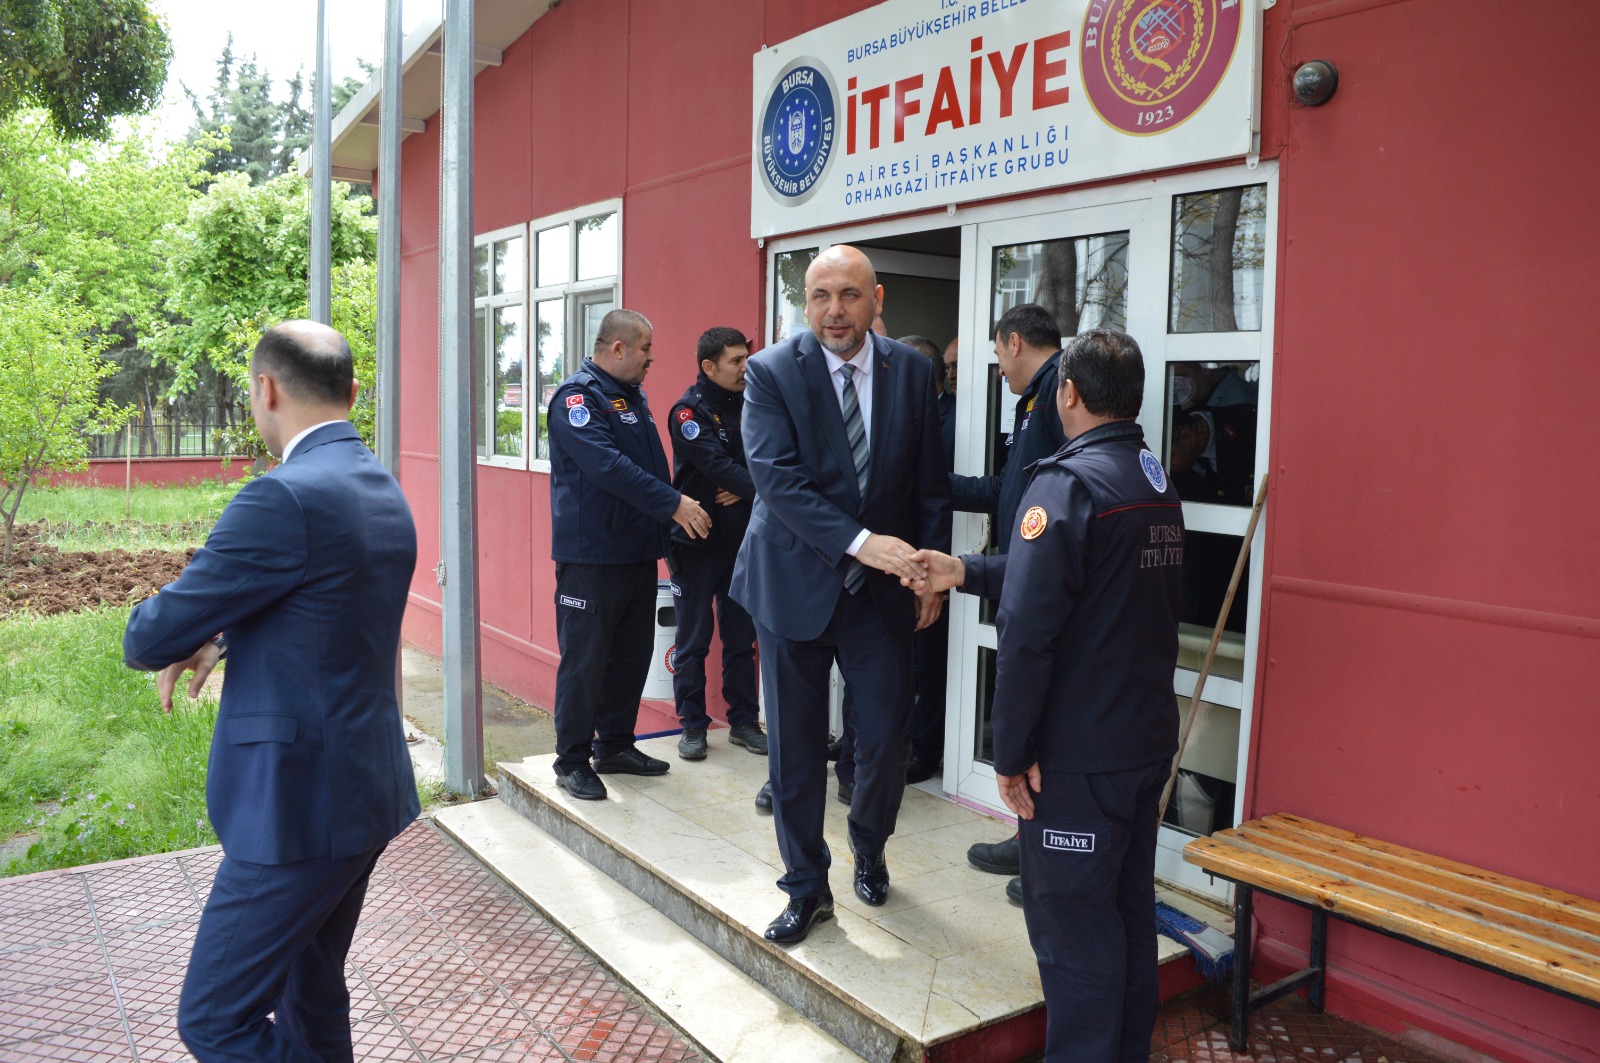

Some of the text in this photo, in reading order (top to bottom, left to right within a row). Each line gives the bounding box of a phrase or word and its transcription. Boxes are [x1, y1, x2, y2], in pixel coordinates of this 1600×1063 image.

[847, 38, 887, 63] BURSA
[890, 4, 977, 48] BÜYÜKŞEHİR
[781, 70, 815, 94] BURSA
[846, 30, 1071, 155] İTFAİYE
[1136, 105, 1175, 125] 1923
[764, 116, 832, 194] BÜYÜKŞEHİR BELEDİYESİ
[845, 148, 1069, 206] ORHANGAZİ İTFAİYE GRUBU
[846, 125, 1069, 187] DAİRESİ BAŞKANLIĞI
[1149, 525, 1182, 543] BURSA
[1050, 833, 1089, 848] İTFAİYE
